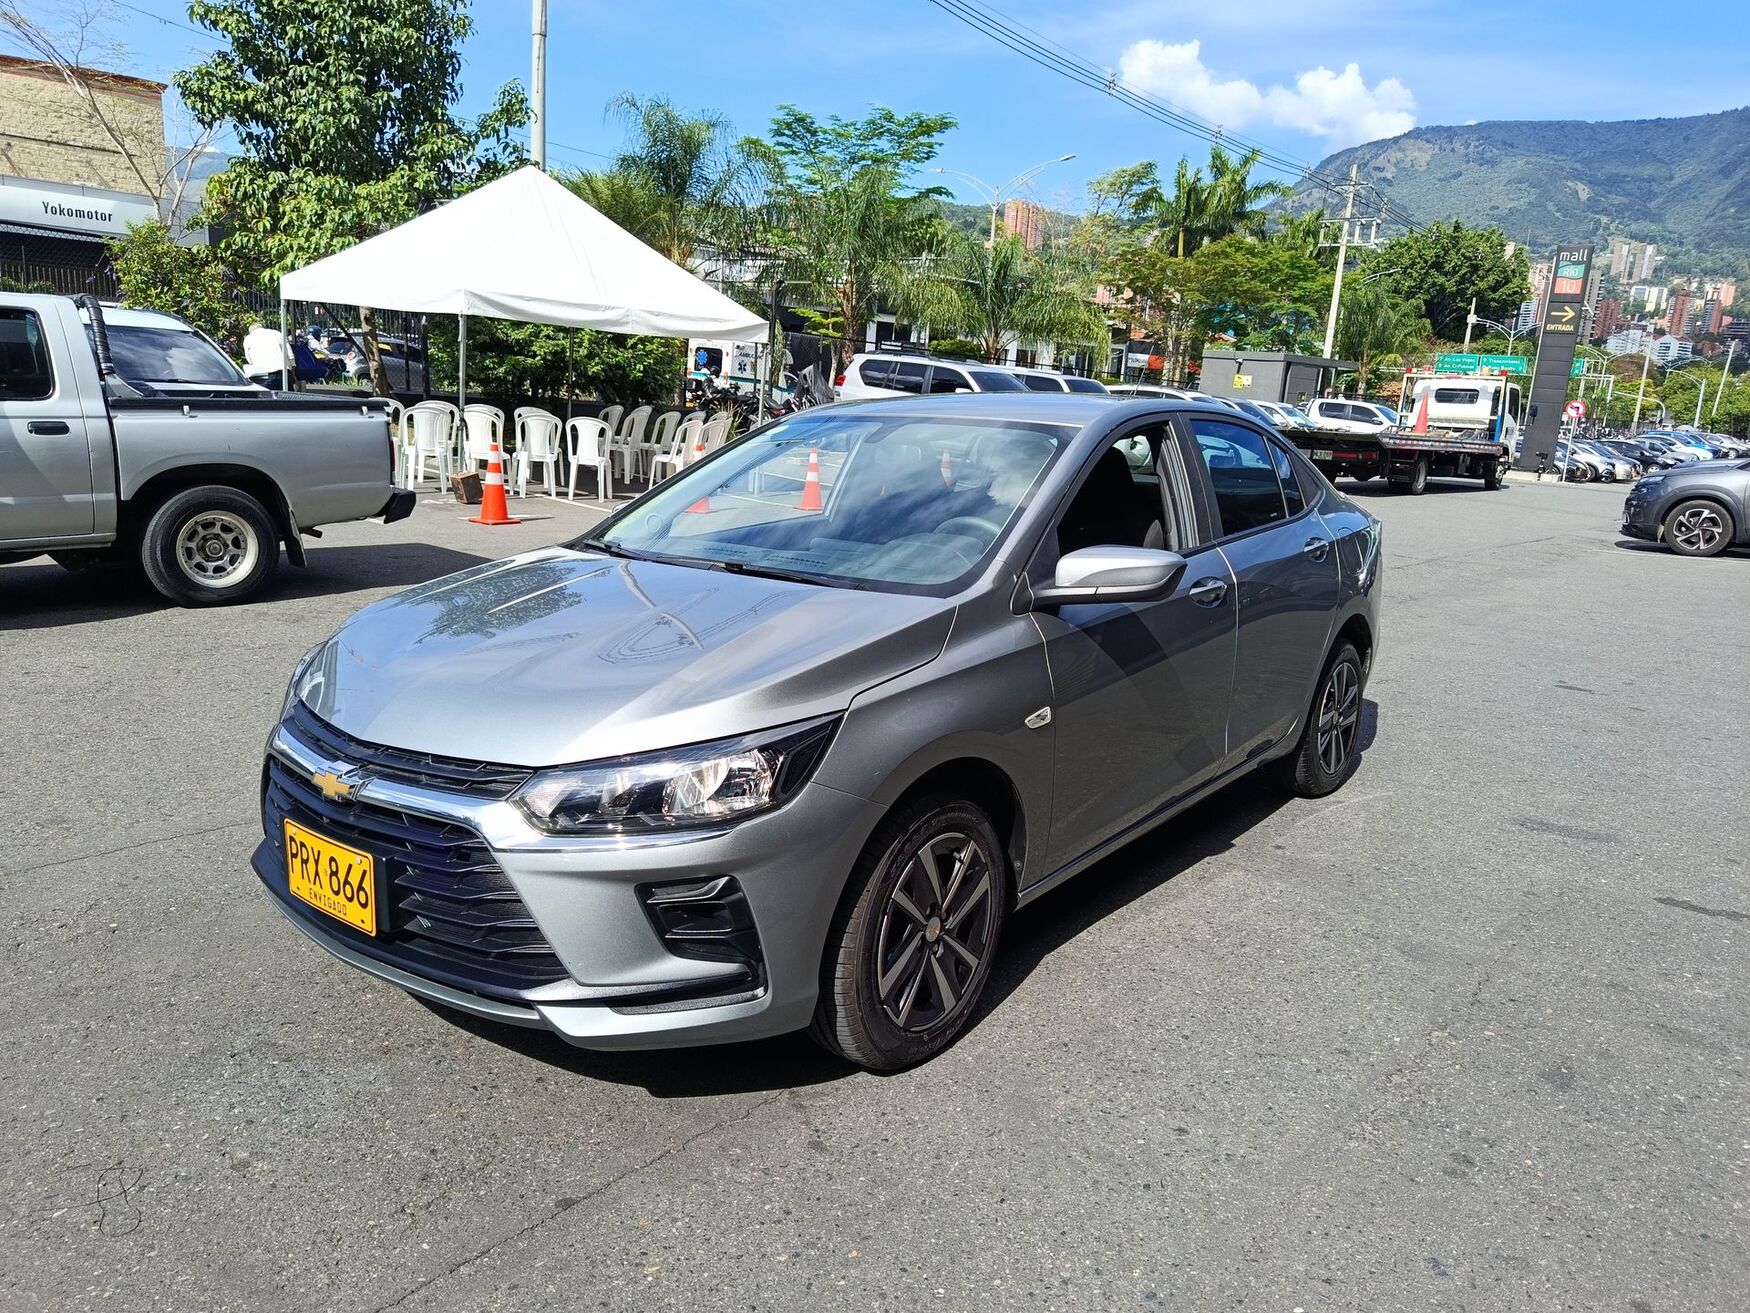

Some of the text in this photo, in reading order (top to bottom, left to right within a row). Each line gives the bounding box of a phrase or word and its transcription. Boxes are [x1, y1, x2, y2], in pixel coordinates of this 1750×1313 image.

[42, 201, 113, 222] Yokomotor
[1560, 249, 1588, 261] mall
[1561, 279, 1577, 294] 10
[1546, 323, 1574, 331] ENTRADA
[289, 834, 369, 909] PRX 866
[308, 887, 348, 916] ENVIGADO
